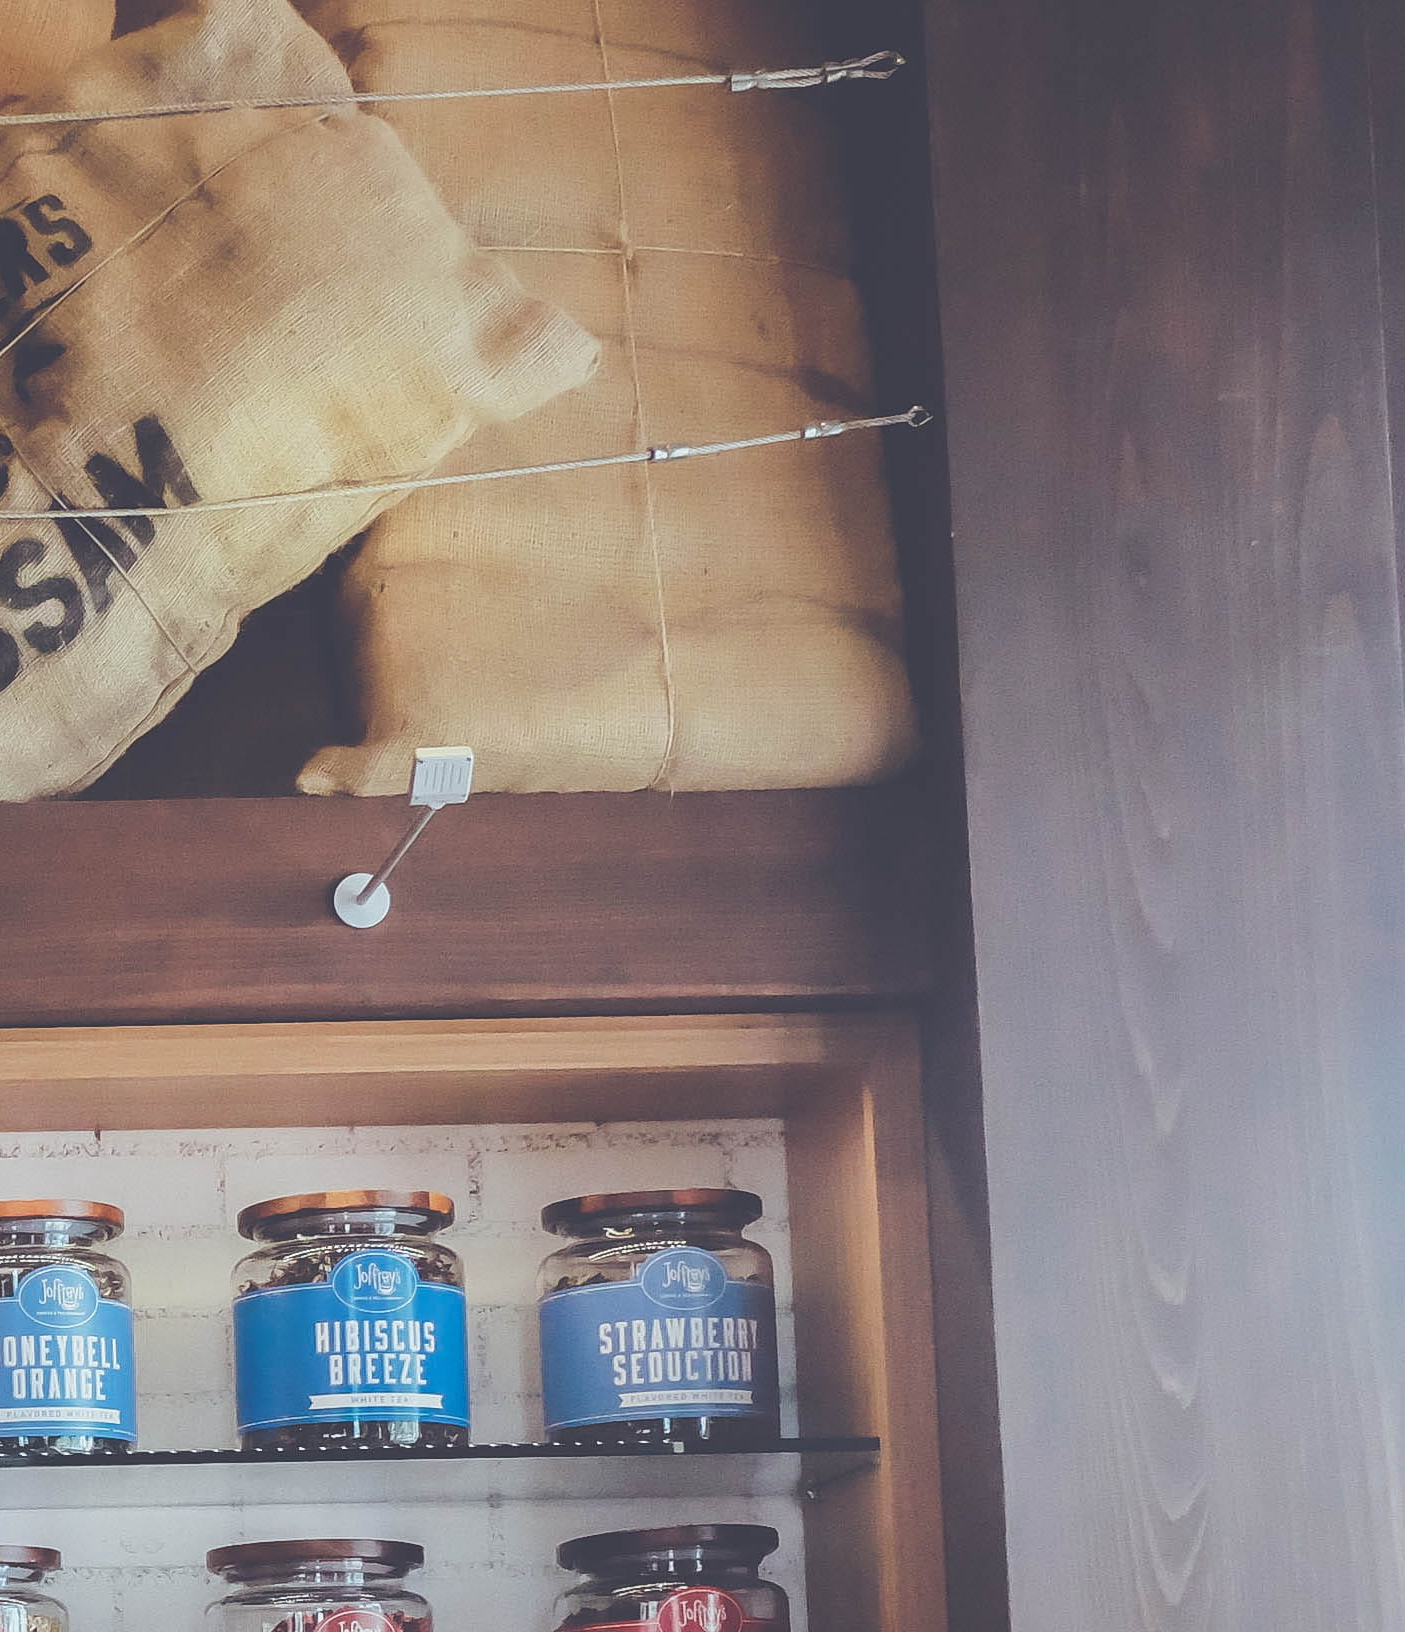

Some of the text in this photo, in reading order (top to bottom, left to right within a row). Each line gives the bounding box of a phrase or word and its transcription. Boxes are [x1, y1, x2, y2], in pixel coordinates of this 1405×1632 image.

[315, 1321, 436, 1354] HIBISCUS
[598, 1317, 758, 1355] STRAWBERRY
[12, 1368, 106, 1401] ORANGE
[328, 1353, 428, 1386] BREEZE
[613, 1351, 753, 1386] SEDUCTION
